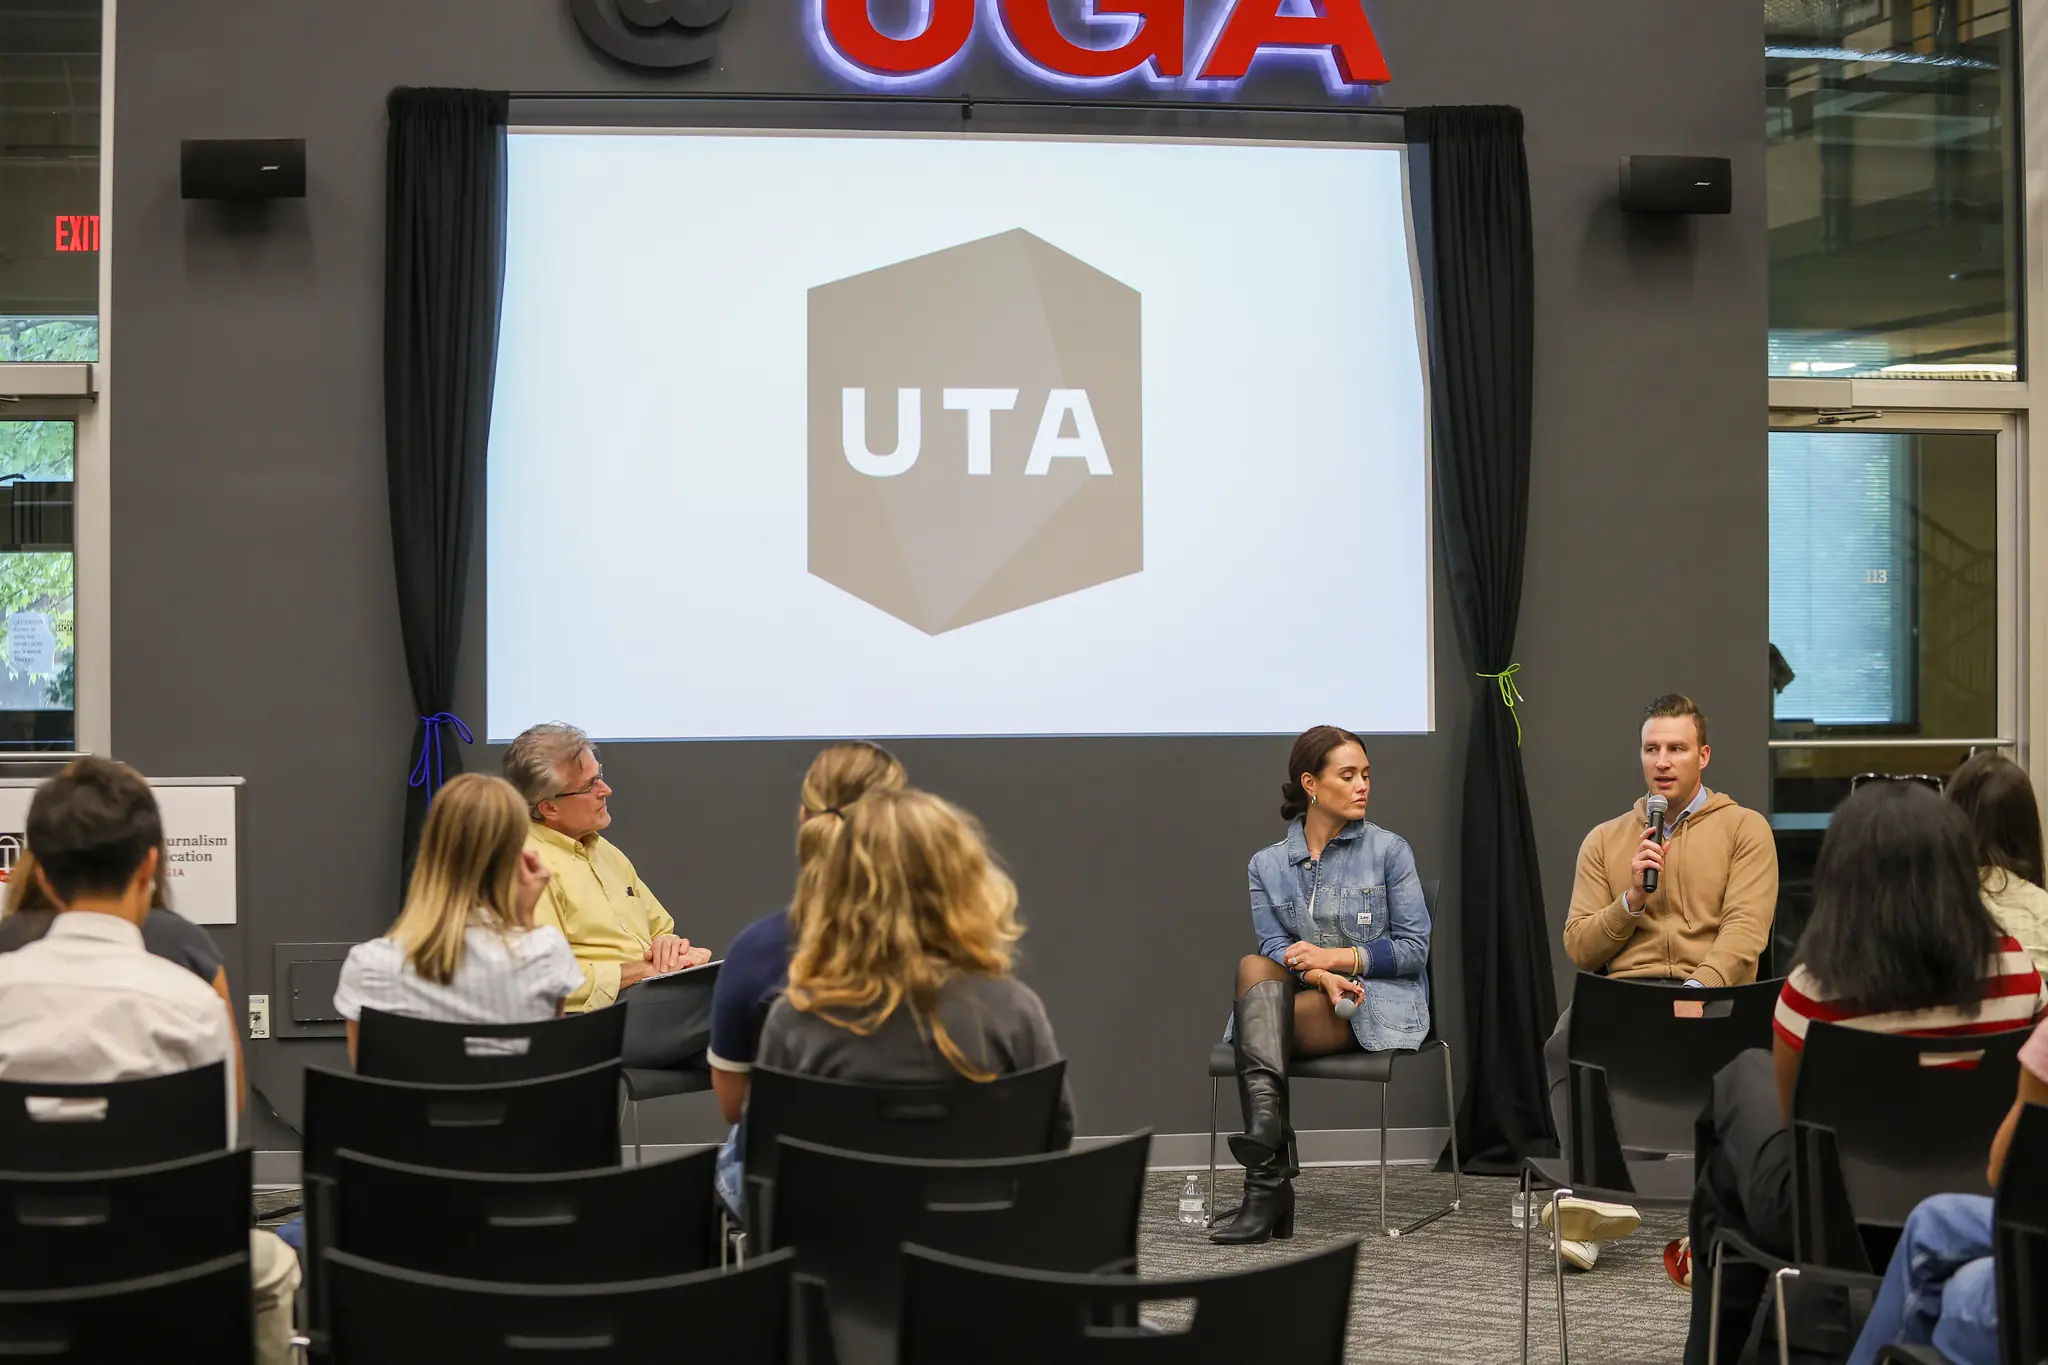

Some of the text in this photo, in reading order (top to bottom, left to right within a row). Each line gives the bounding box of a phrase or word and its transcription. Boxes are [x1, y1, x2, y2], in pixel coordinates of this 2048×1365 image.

[55, 215, 100, 252] EXIT
[842, 387, 1113, 477] UTA
[1865, 569, 1887, 584] 113
[166, 834, 228, 847] urnalism
[167, 850, 213, 862] cation
